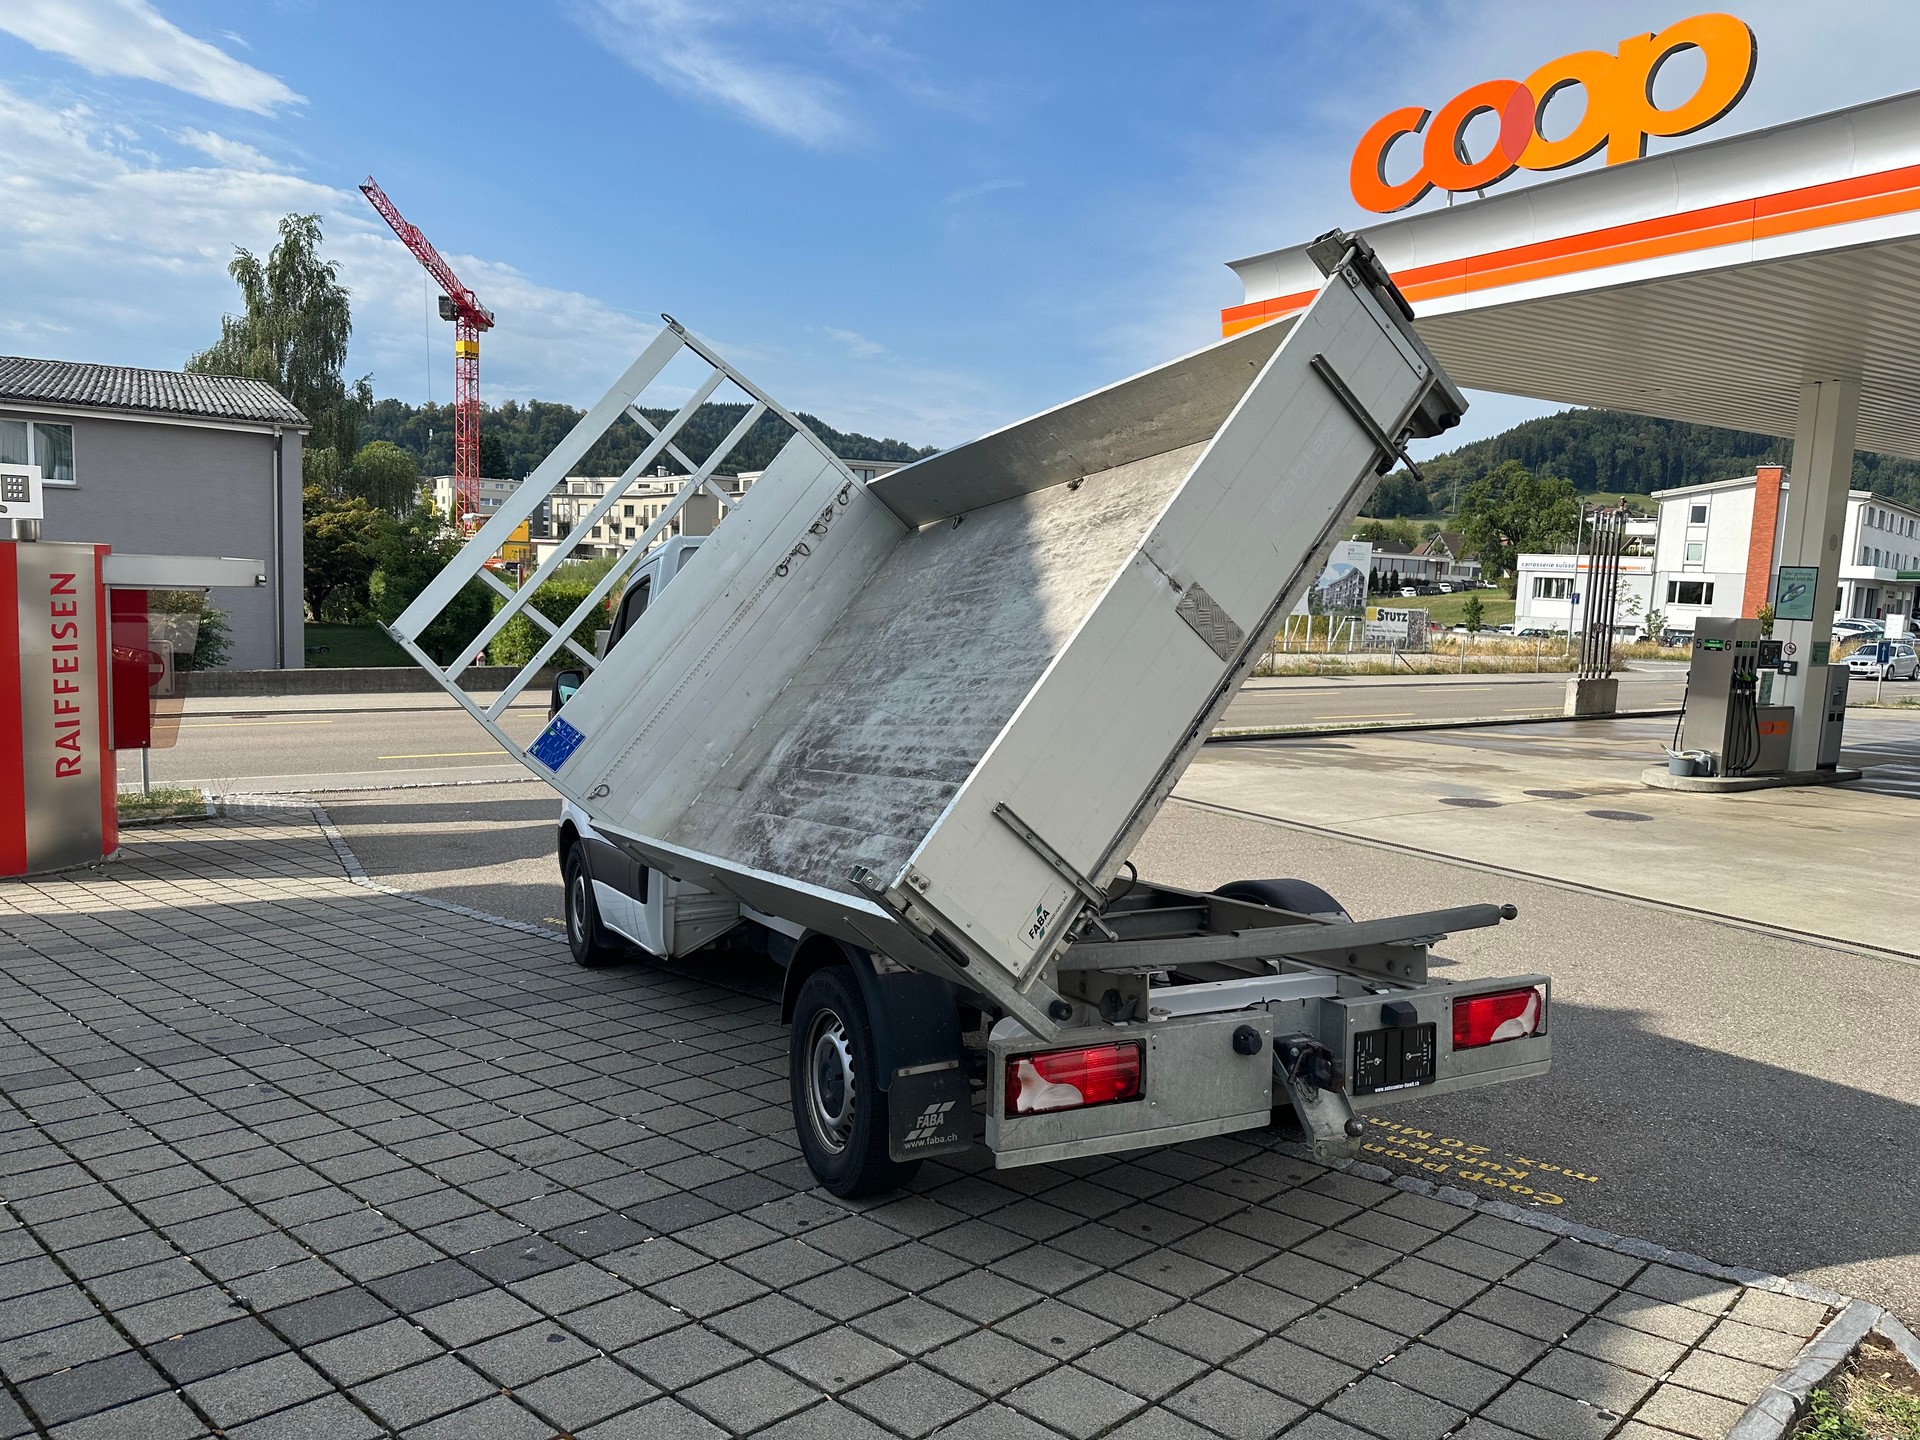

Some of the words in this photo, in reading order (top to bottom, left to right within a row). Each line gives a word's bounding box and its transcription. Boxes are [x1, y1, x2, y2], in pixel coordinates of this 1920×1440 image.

[1349, 12, 1758, 214] coop
[1377, 608, 1408, 622] STUTZ
[1696, 638, 1702, 649] 5
[1724, 640, 1732, 651] 6
[50, 573, 82, 779] RAIFFEISEN
[1028, 909, 1050, 939] FABA
[916, 1113, 944, 1129] FABA
[1360, 1114, 1433, 1139] Min.
[904, 1133, 958, 1150] www.faba.ch
[1440, 1138, 1491, 1155] 20
[1387, 1136, 1529, 1180] Kunden
[1504, 1153, 1599, 1183] max.
[1458, 1170, 1564, 1205] Coop
